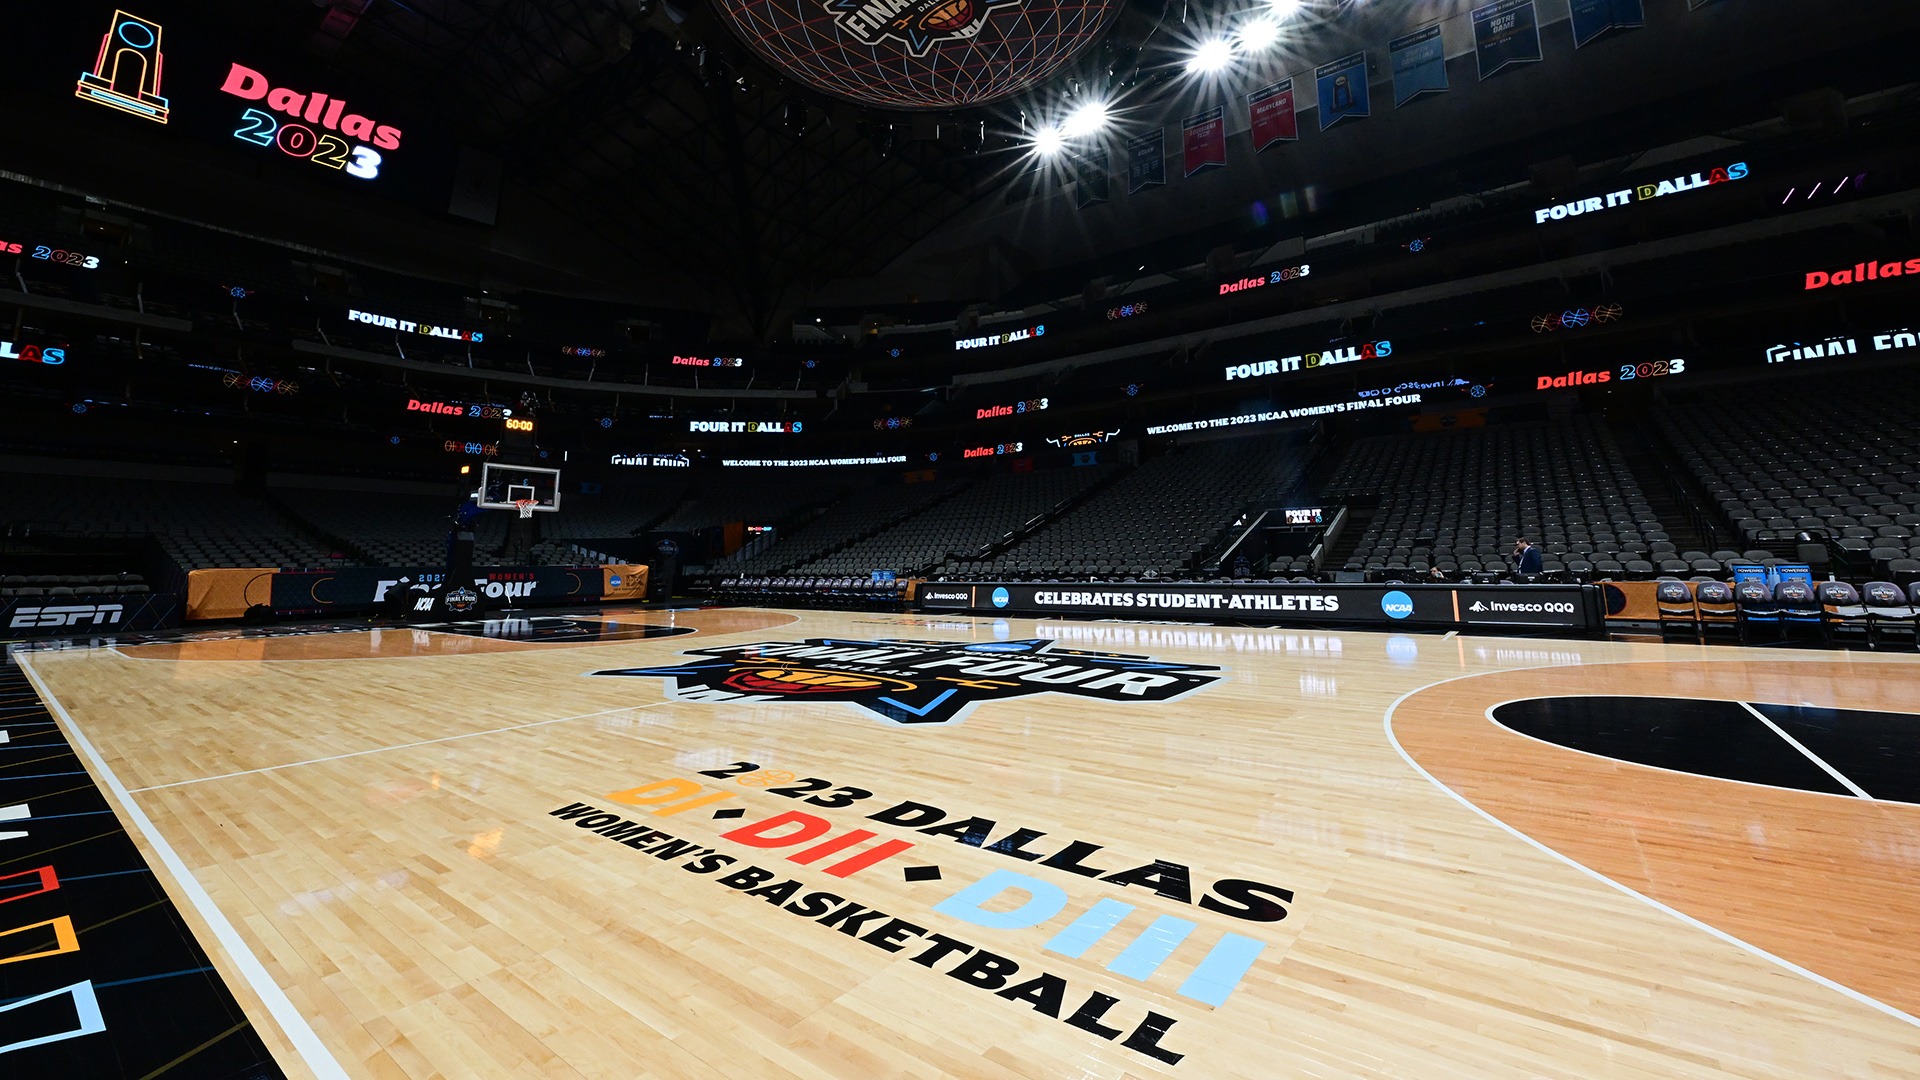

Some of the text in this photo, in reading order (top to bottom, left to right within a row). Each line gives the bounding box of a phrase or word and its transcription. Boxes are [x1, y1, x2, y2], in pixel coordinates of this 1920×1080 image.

[918, 0, 940, 12] DAL
[845, 0, 917, 39] FINA
[1490, 12, 1516, 28] NOTRE
[1492, 20, 1515, 34] DAME
[220, 62, 402, 150] Dallas
[1256, 98, 1286, 114] MARYLAND
[1189, 122, 1216, 136] LOUISIANA
[234, 108, 382, 179] 2023
[1535, 162, 1749, 224] FOUR IT DALLAS
[32, 245, 100, 269] 2023
[1220, 264, 1310, 295] Dallas 2023
[1805, 258, 1920, 290] Dallas
[348, 309, 484, 342] FOUR IT DALLAS
[955, 325, 1045, 350] FOUR IT DALLAS
[672, 356, 742, 367] Dallas 2023
[1226, 340, 1392, 380] FOUR IT DALLAS
[1536, 358, 1685, 390] Dallas 2023
[406, 399, 463, 416] Dallas
[976, 398, 1048, 419] Dallas 2023
[1147, 394, 1421, 435] WELCOME TO THE 2023 NCAA WOMEN'S FINAL FOUR
[506, 418, 533, 431] 60:00
[690, 421, 802, 432] FOUR IT DALLAS
[964, 442, 1023, 458] Dallas 2023
[488, 572, 535, 581] WOMEN'S
[1034, 591, 1339, 612] CELEBRATES STUDENT-ATHLETES
[1385, 604, 1412, 612] NCAA
[1490, 601, 1575, 613] Invesco QQQ
[9, 604, 123, 628] ESPN
[814, 663, 918, 676] DALLAS
[909, 656, 1180, 695] FOUR
[866, 799, 1294, 922] DALLAS
[606, 776, 1267, 1008] DI DII DIII
[548, 802, 1186, 1066] WOMEN'S BASKETBALL
